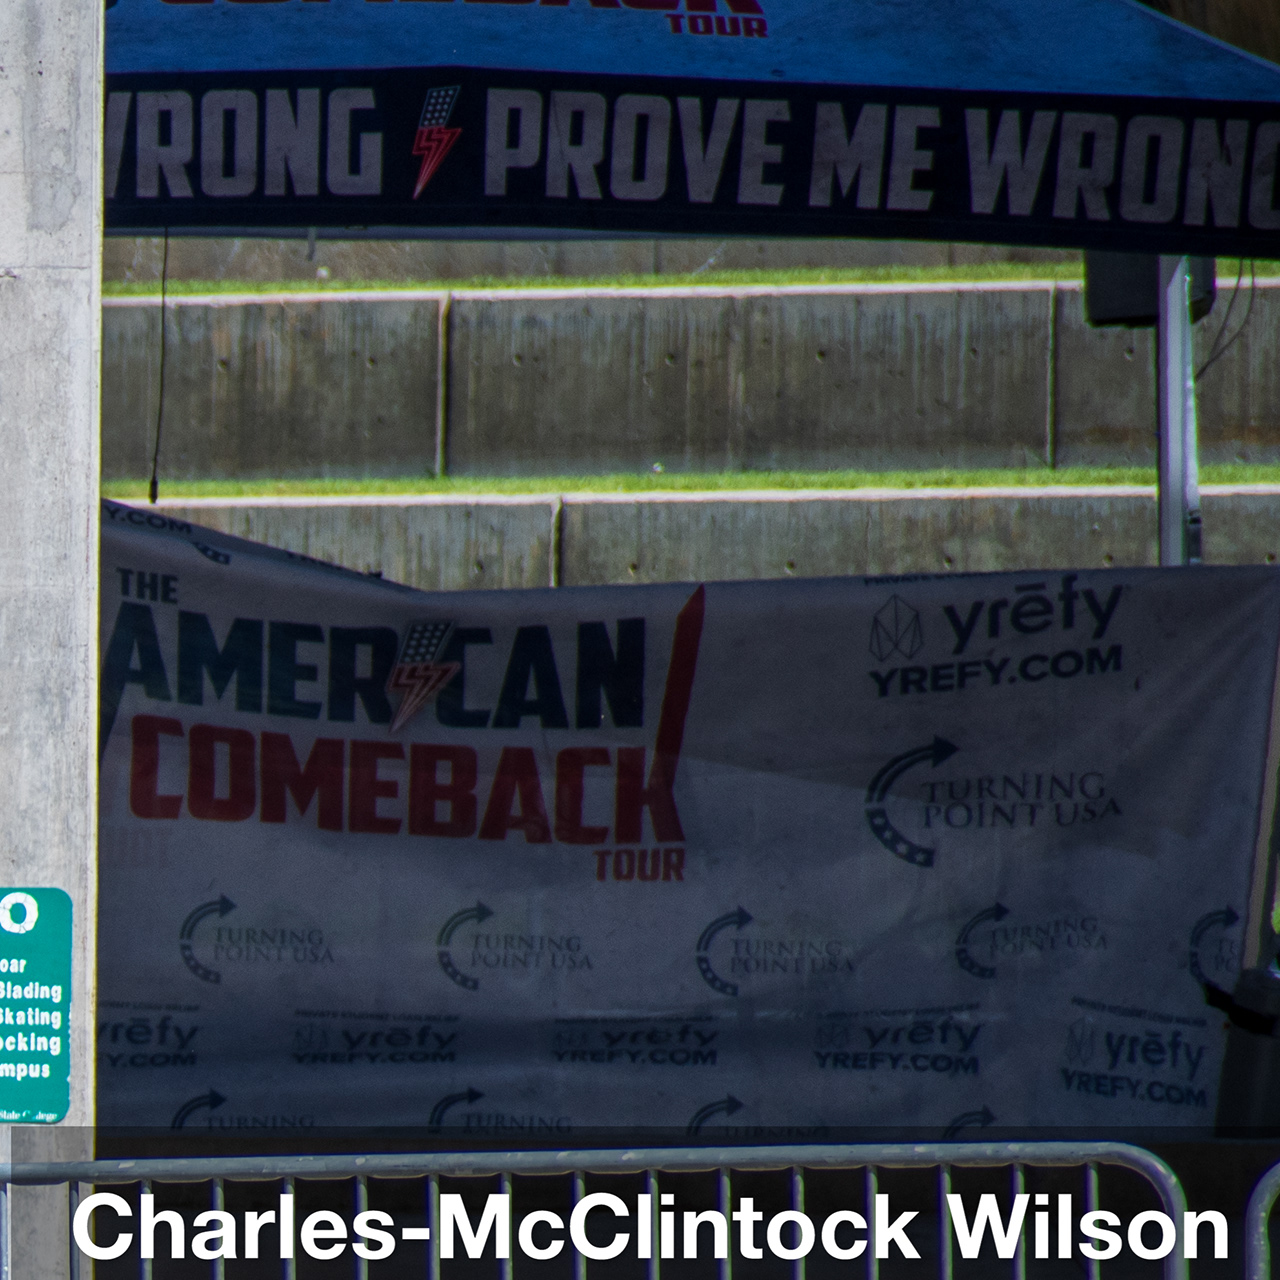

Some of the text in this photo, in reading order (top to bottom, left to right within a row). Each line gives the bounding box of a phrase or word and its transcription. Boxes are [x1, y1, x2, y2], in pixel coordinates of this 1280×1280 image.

[666, 12, 769, 39] TOUR
[105, 87, 383, 197] RONG
[484, 87, 793, 206] PROVE
[809, 101, 943, 212] ME
[115, 566, 179, 604] THE
[868, 644, 1123, 698] YREFY.COM
[129, 650, 700, 846] COMEBACK
[921, 771, 1106, 803] TURNING
[923, 798, 1123, 829] POINT USA
[593, 847, 685, 882] TOUR
[213, 925, 324, 947] TURNING
[471, 931, 582, 953] TURNING
[731, 938, 842, 956] TURNING
[814, 1051, 980, 1075] YREFY.COM
[1061, 1067, 1208, 1108] YREFY.COM
